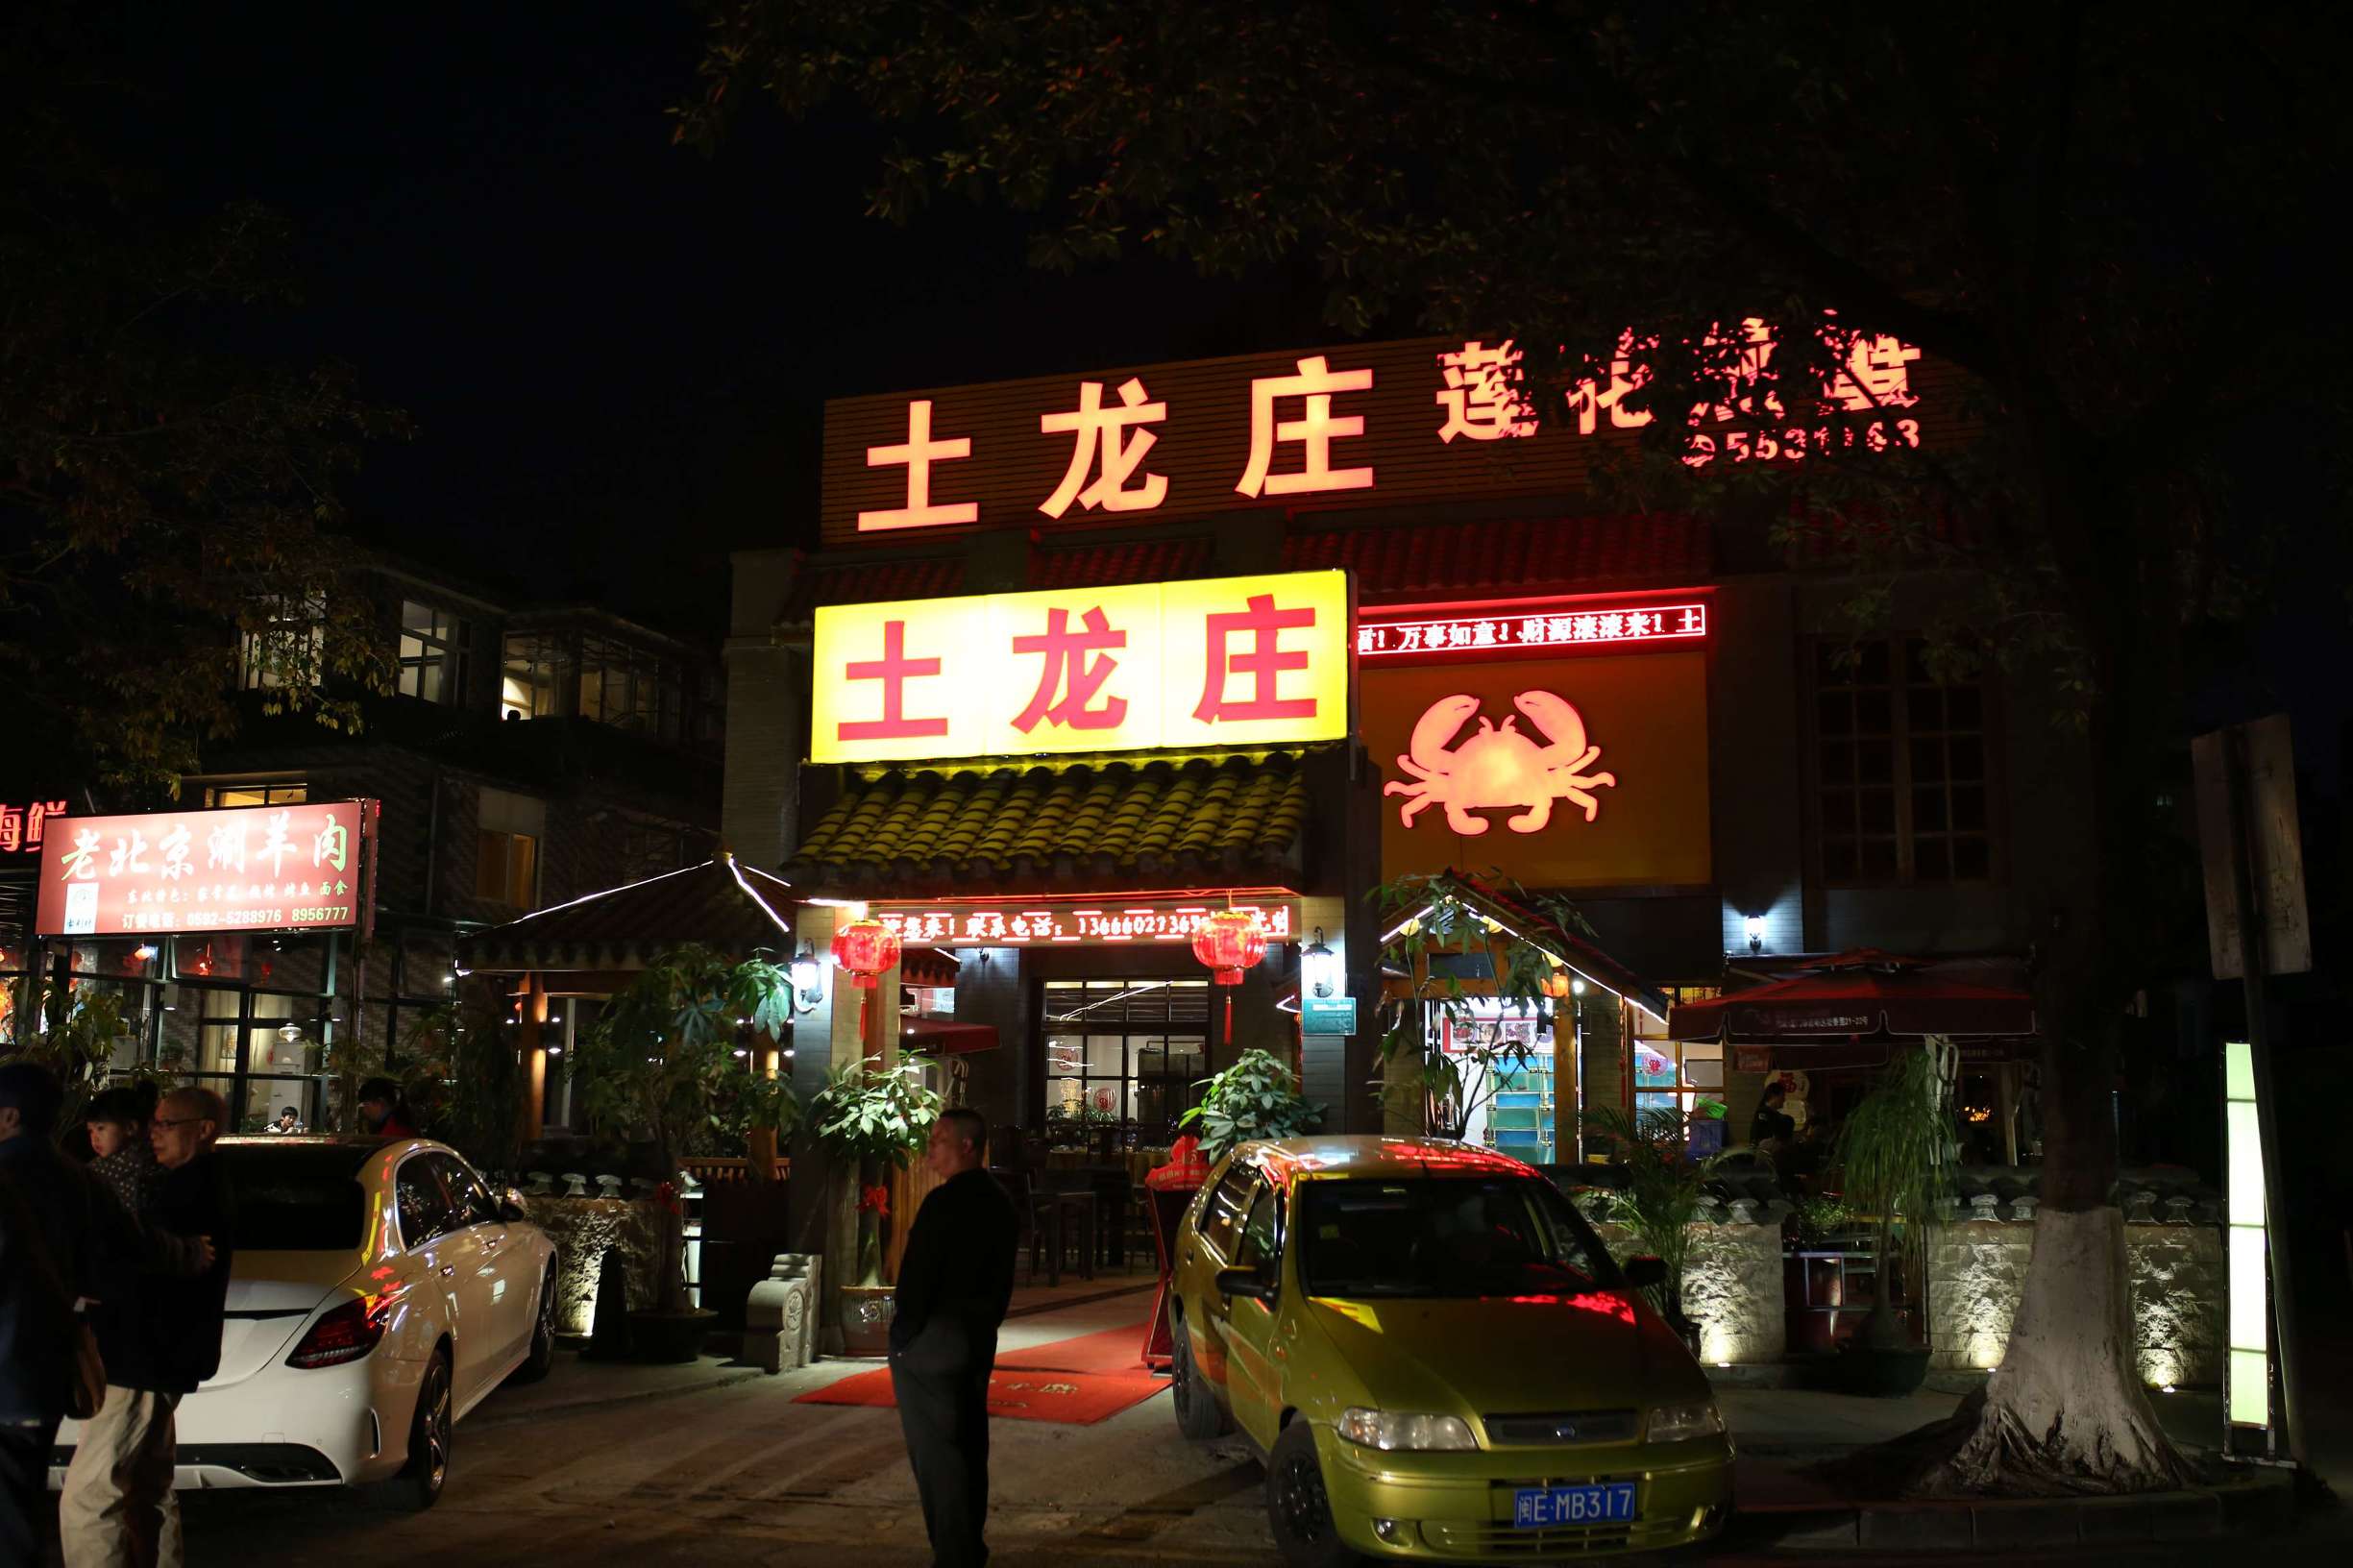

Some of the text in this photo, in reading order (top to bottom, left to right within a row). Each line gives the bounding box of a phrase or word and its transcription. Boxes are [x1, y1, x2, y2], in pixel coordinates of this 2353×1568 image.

[857, 355, 1374, 532] 土龙庄
[837, 593, 1318, 742] 土龙庄
[61, 810, 348, 881] 老北京涮羊肉
[291, 906, 349, 922] 8956777
[320, 879, 348, 896] 面食
